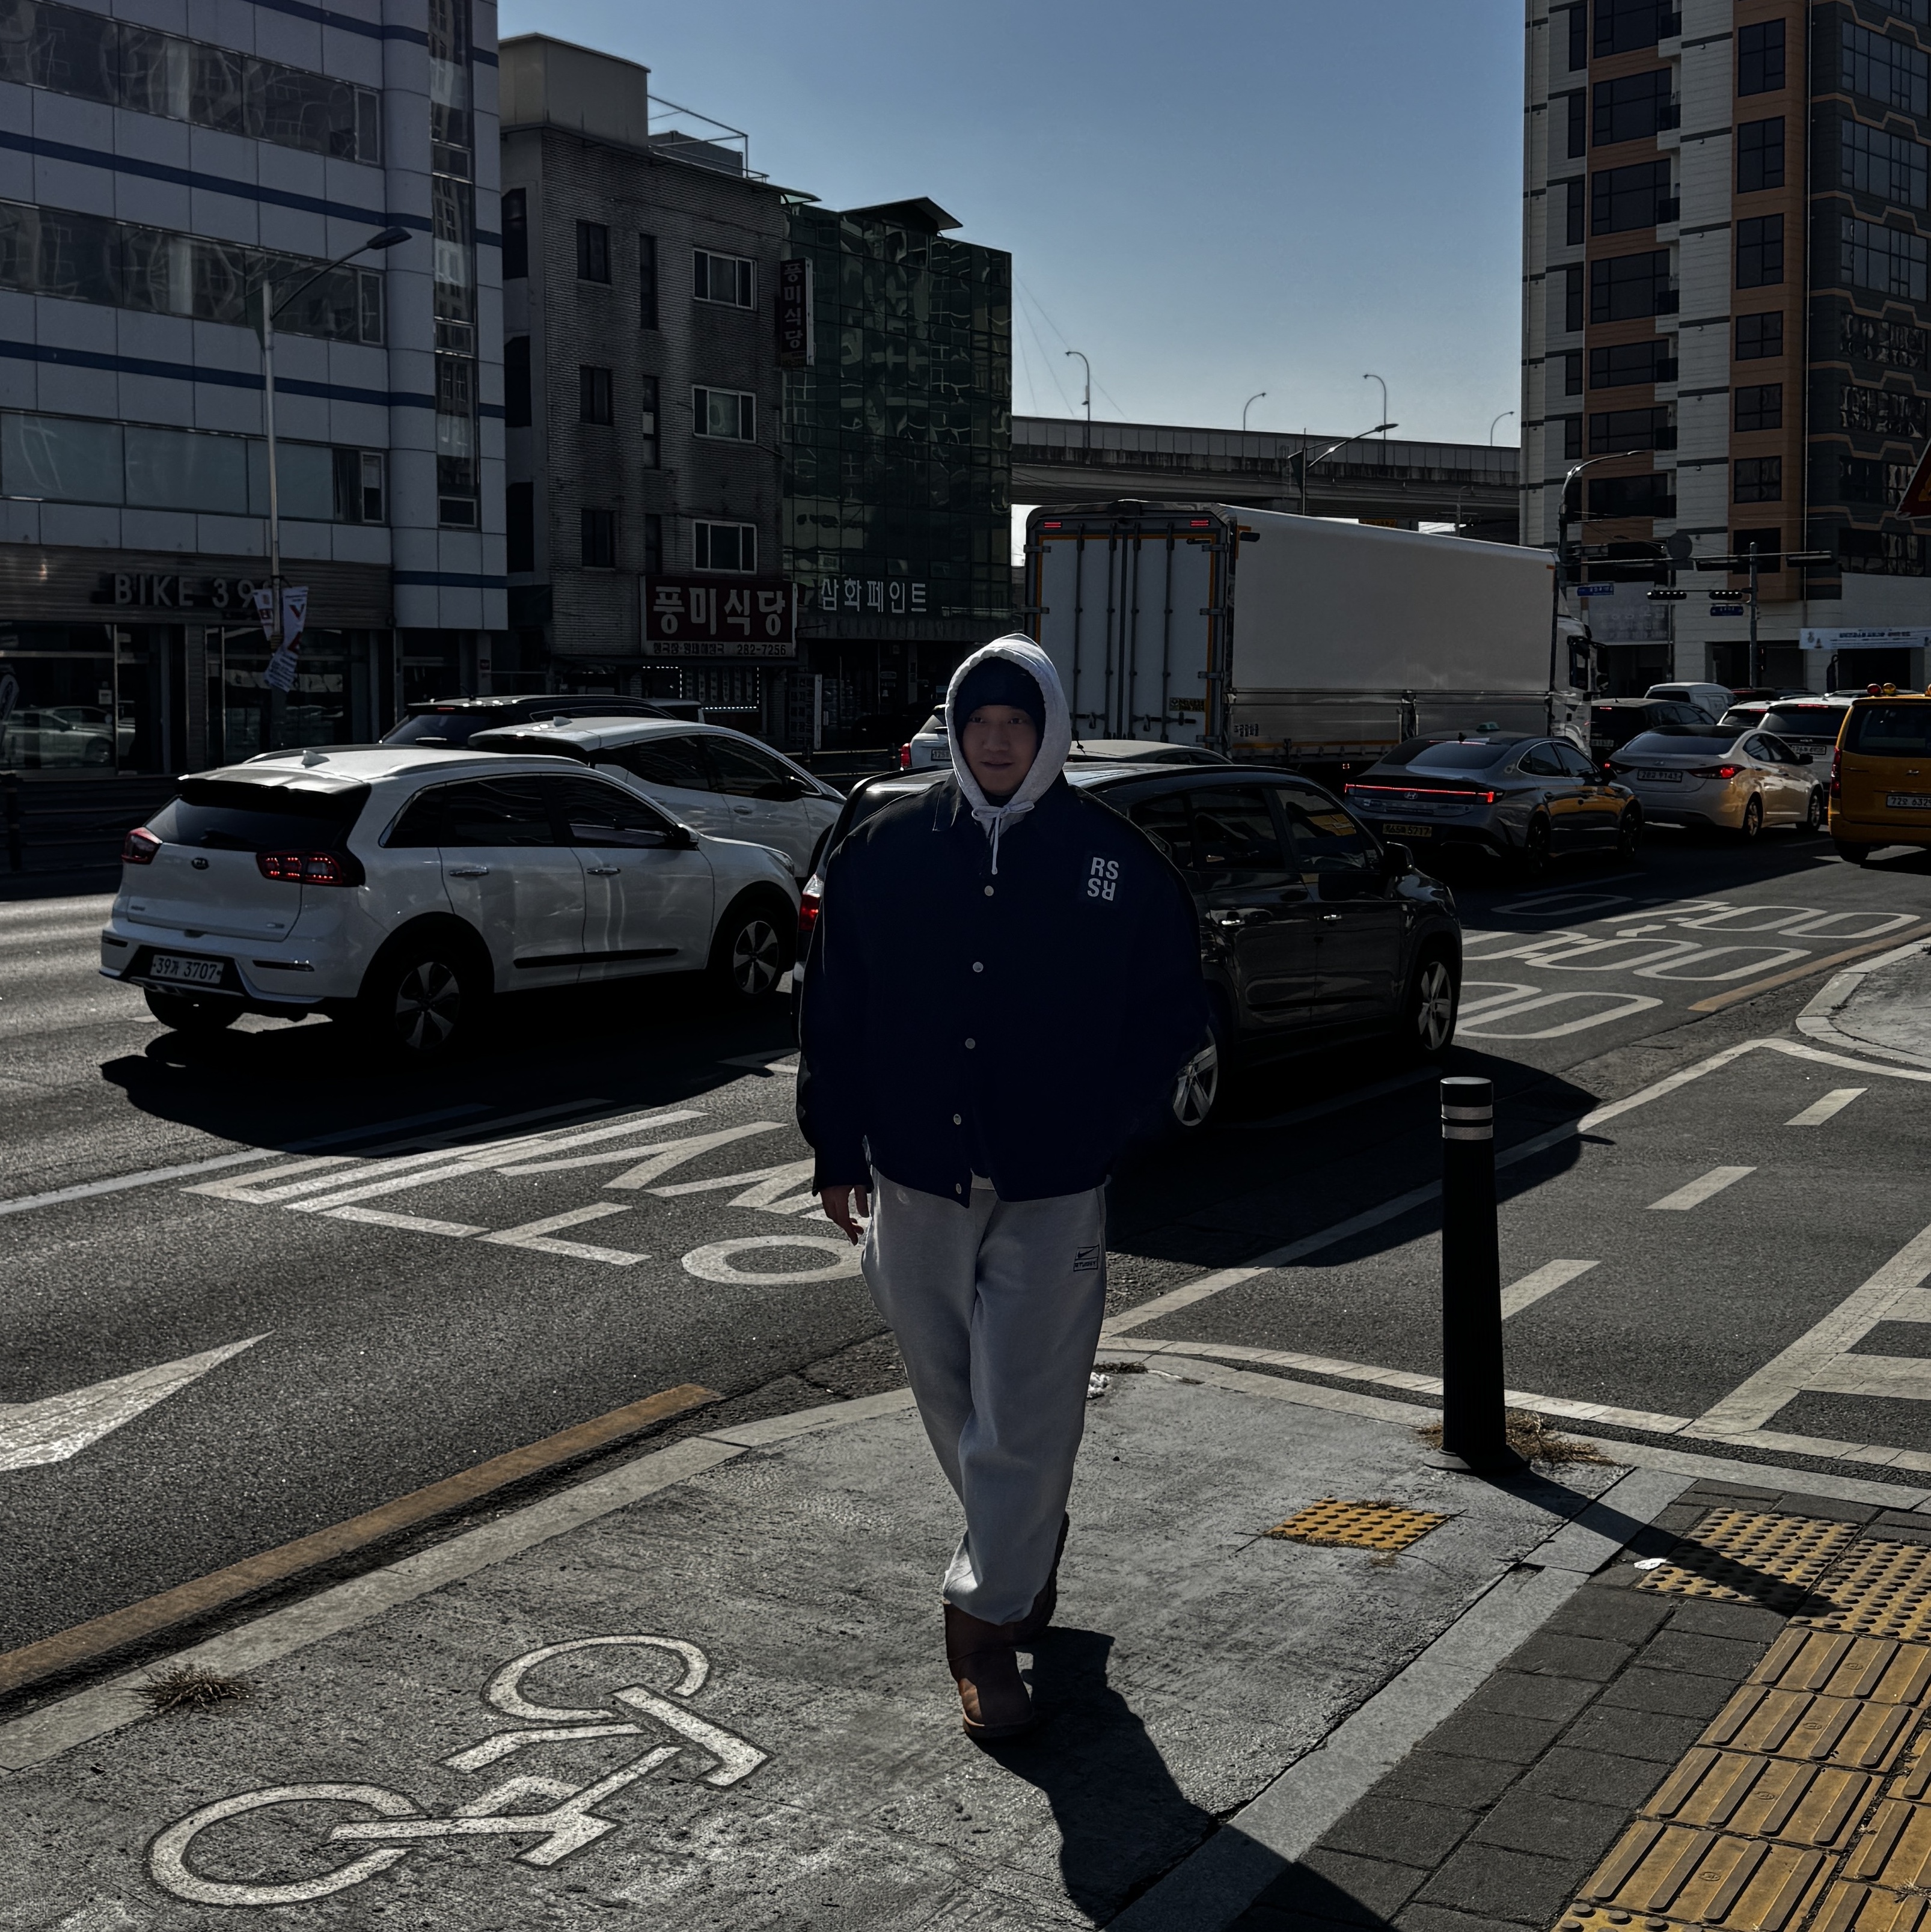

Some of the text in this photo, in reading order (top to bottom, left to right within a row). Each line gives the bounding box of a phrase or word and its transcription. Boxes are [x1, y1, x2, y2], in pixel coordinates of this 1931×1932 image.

[783, 263, 803, 349] 풍미식당
[114, 574, 194, 607] BIKE
[821, 577, 927, 614] 삼화페인트
[652, 585, 786, 637] 풍미식당
[737, 644, 786, 655] 282-7256
[1090, 857, 1119, 880] RS
[184, 961, 217, 980] 3707
